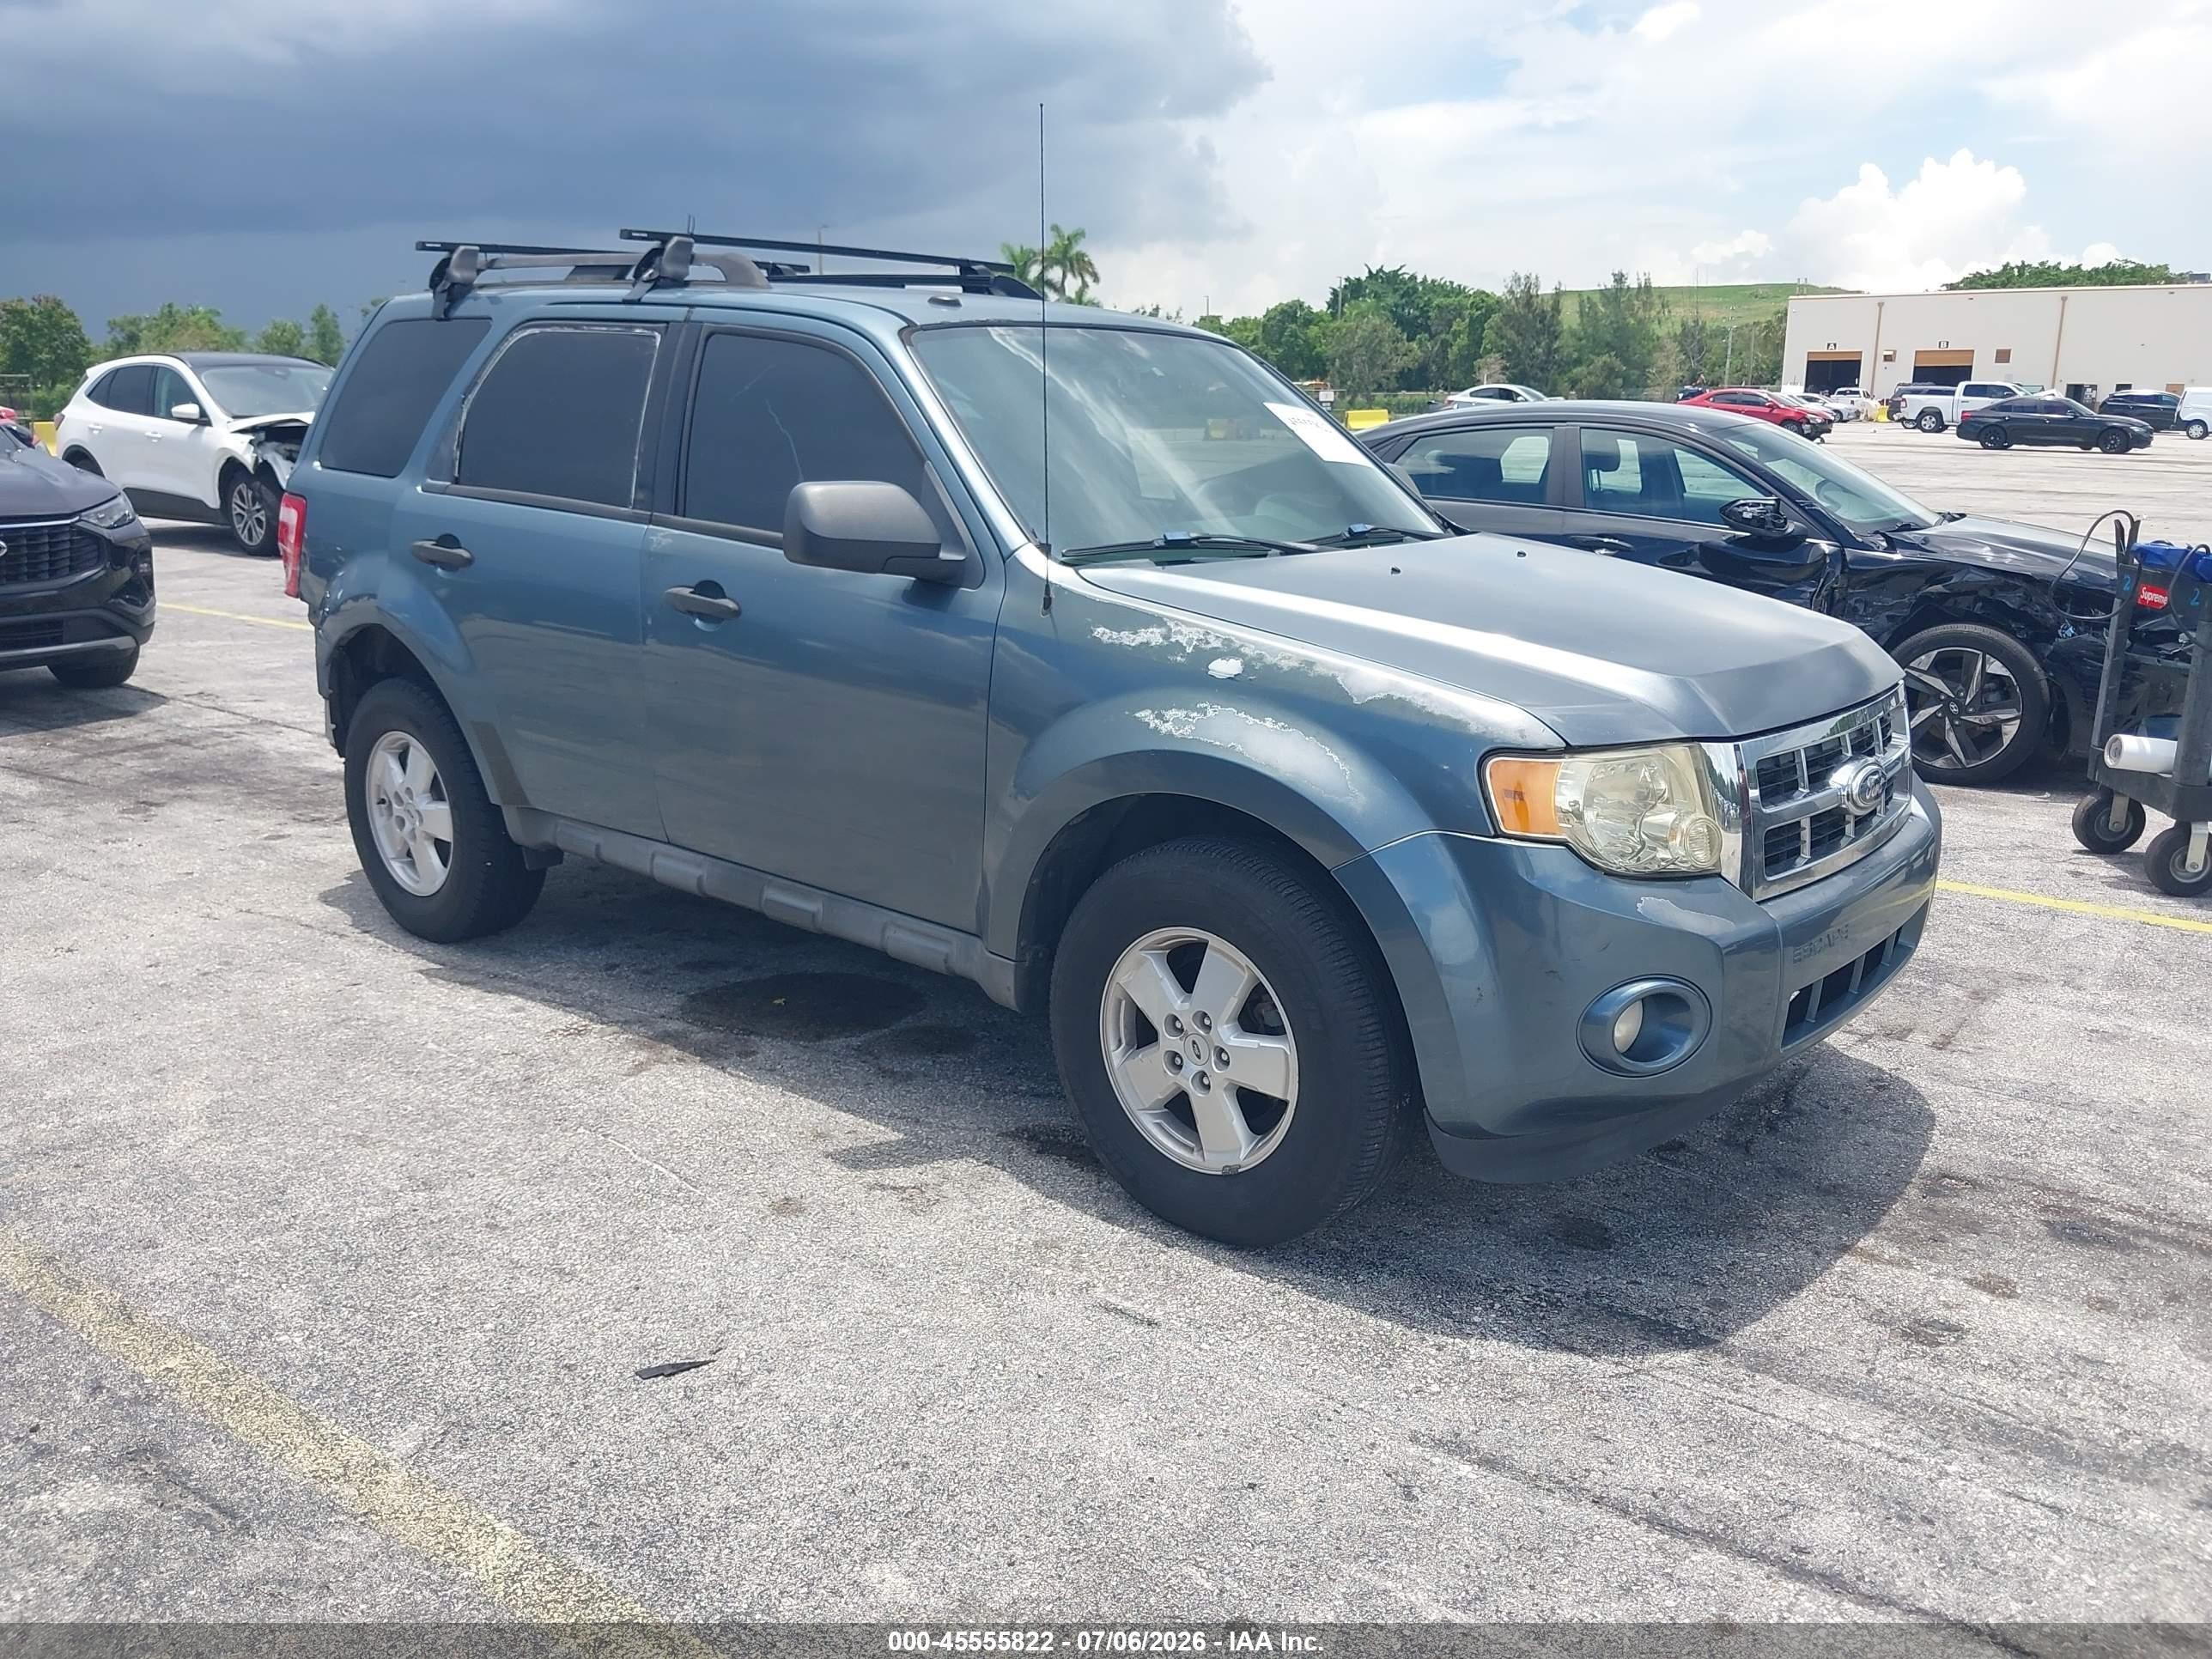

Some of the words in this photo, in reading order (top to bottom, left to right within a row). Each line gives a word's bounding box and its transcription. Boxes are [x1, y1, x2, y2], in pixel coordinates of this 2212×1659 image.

[2123, 575, 2131, 591] 2
[2140, 586, 2168, 605] Supreme
[2190, 587, 2200, 605] 2
